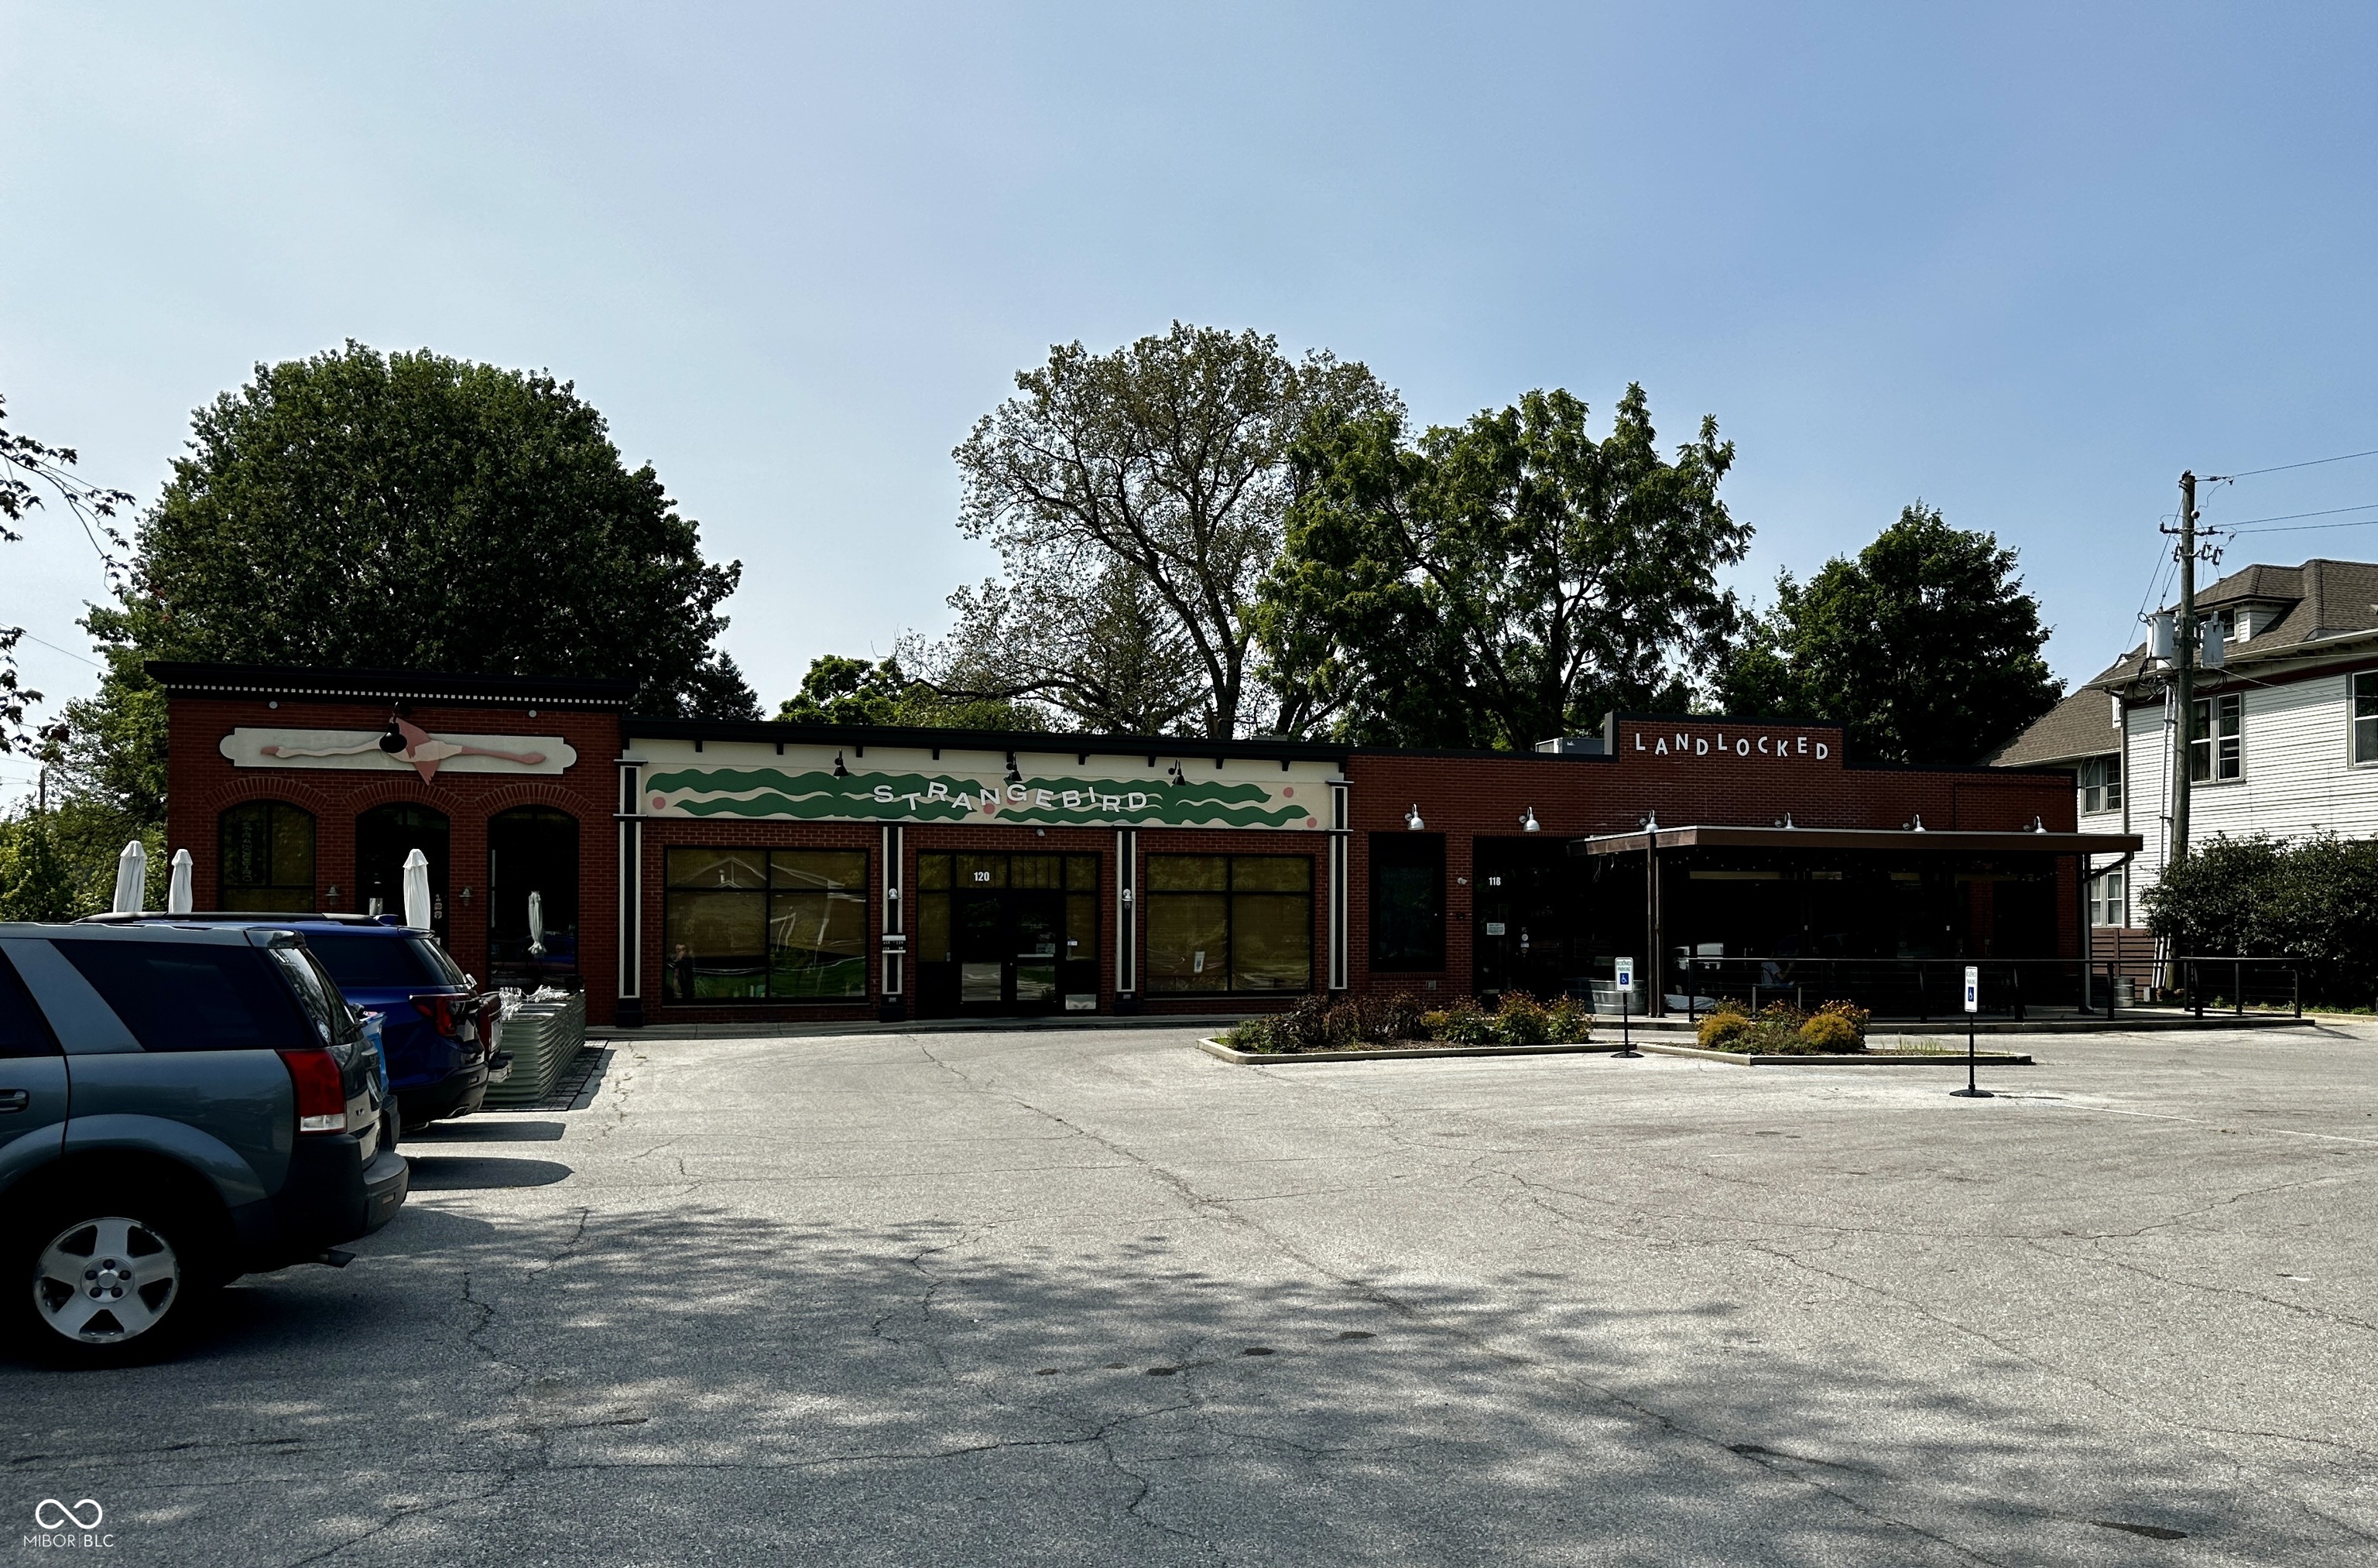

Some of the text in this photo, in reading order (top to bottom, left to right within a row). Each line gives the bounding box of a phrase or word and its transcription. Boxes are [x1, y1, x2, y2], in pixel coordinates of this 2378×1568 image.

[1636, 733, 1828, 760] LANDLOCKED
[873, 781, 1148, 813] STRANGEBIRD
[973, 871, 990, 882] 120
[1488, 876, 1501, 886] 118
